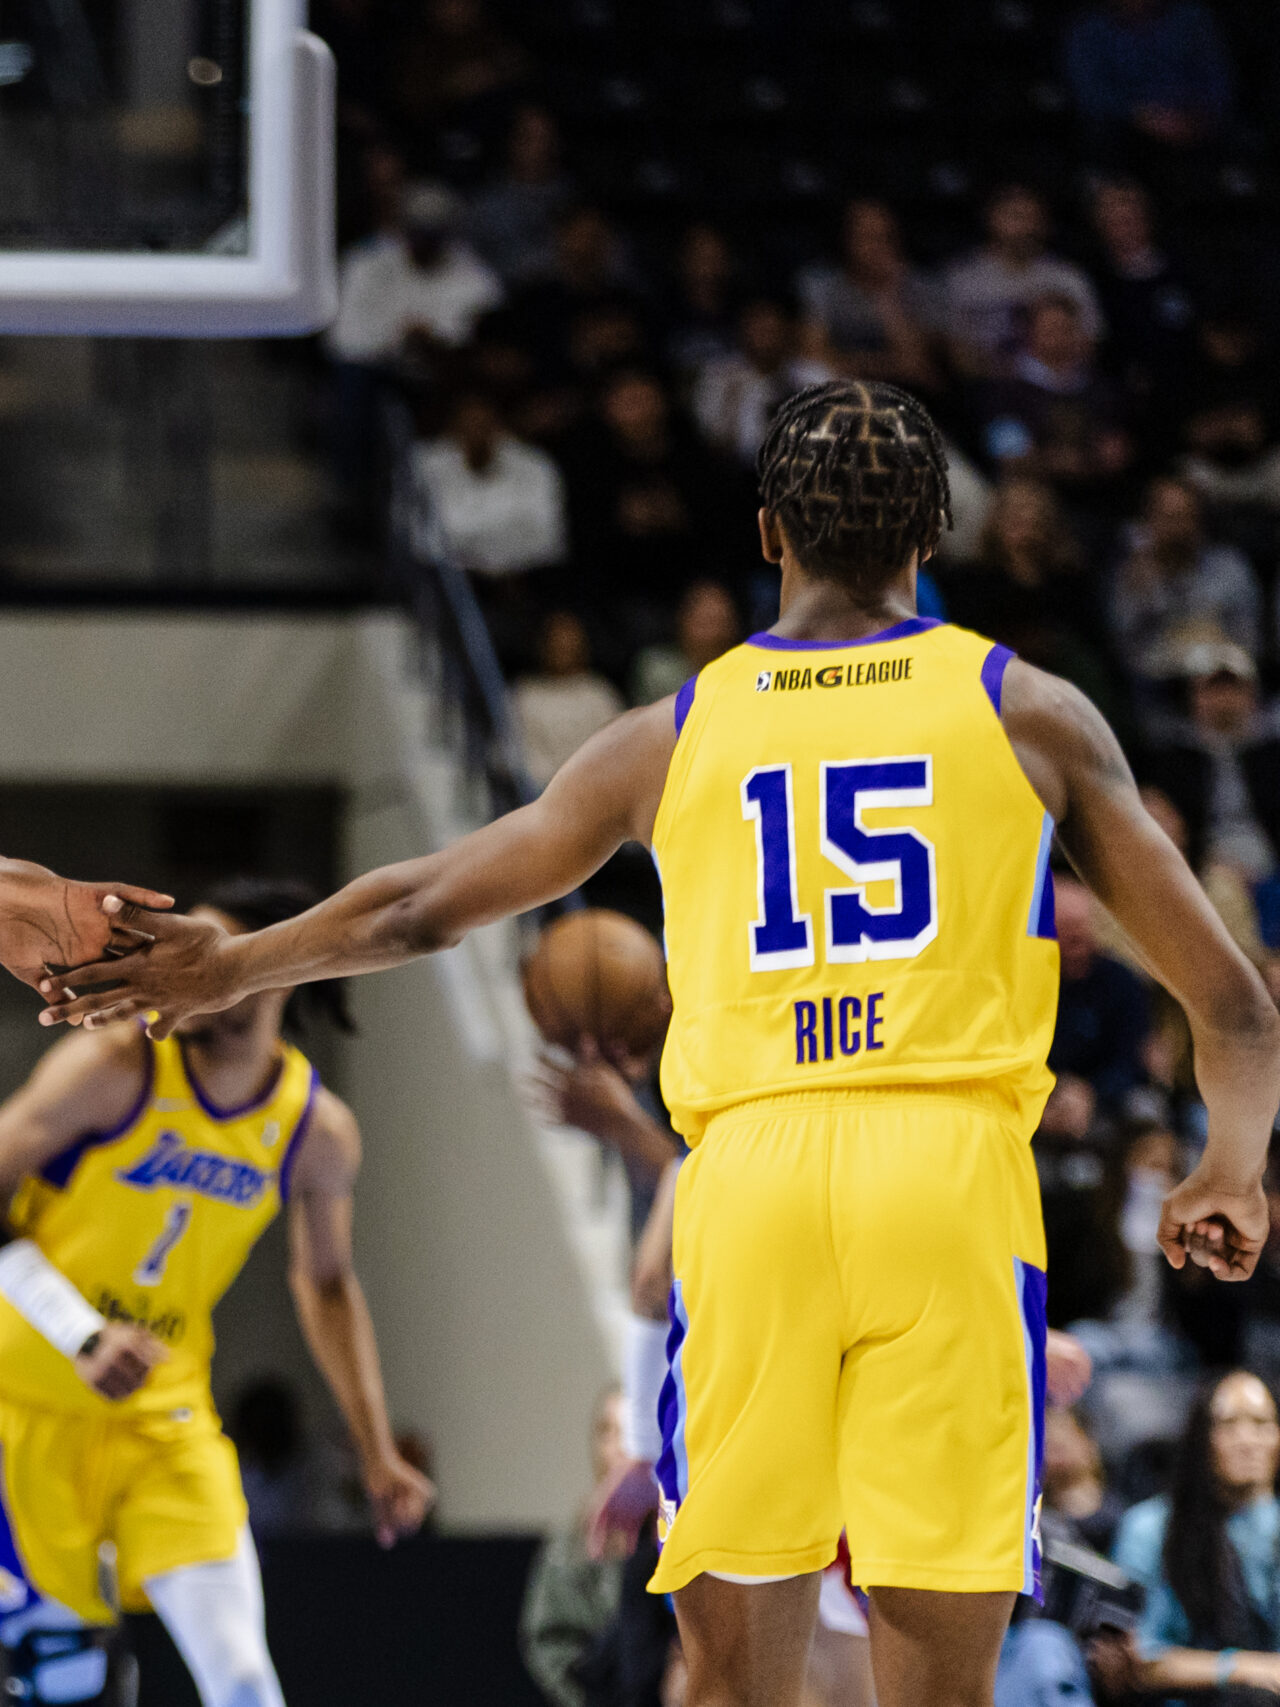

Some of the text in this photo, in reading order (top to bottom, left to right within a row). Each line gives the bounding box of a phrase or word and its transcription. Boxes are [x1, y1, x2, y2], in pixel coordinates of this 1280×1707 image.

[773, 657, 913, 691] NBA G LEAGUE
[739, 754, 939, 973] 15
[794, 992, 884, 1065] RICE
[133, 1198, 192, 1287] 1
